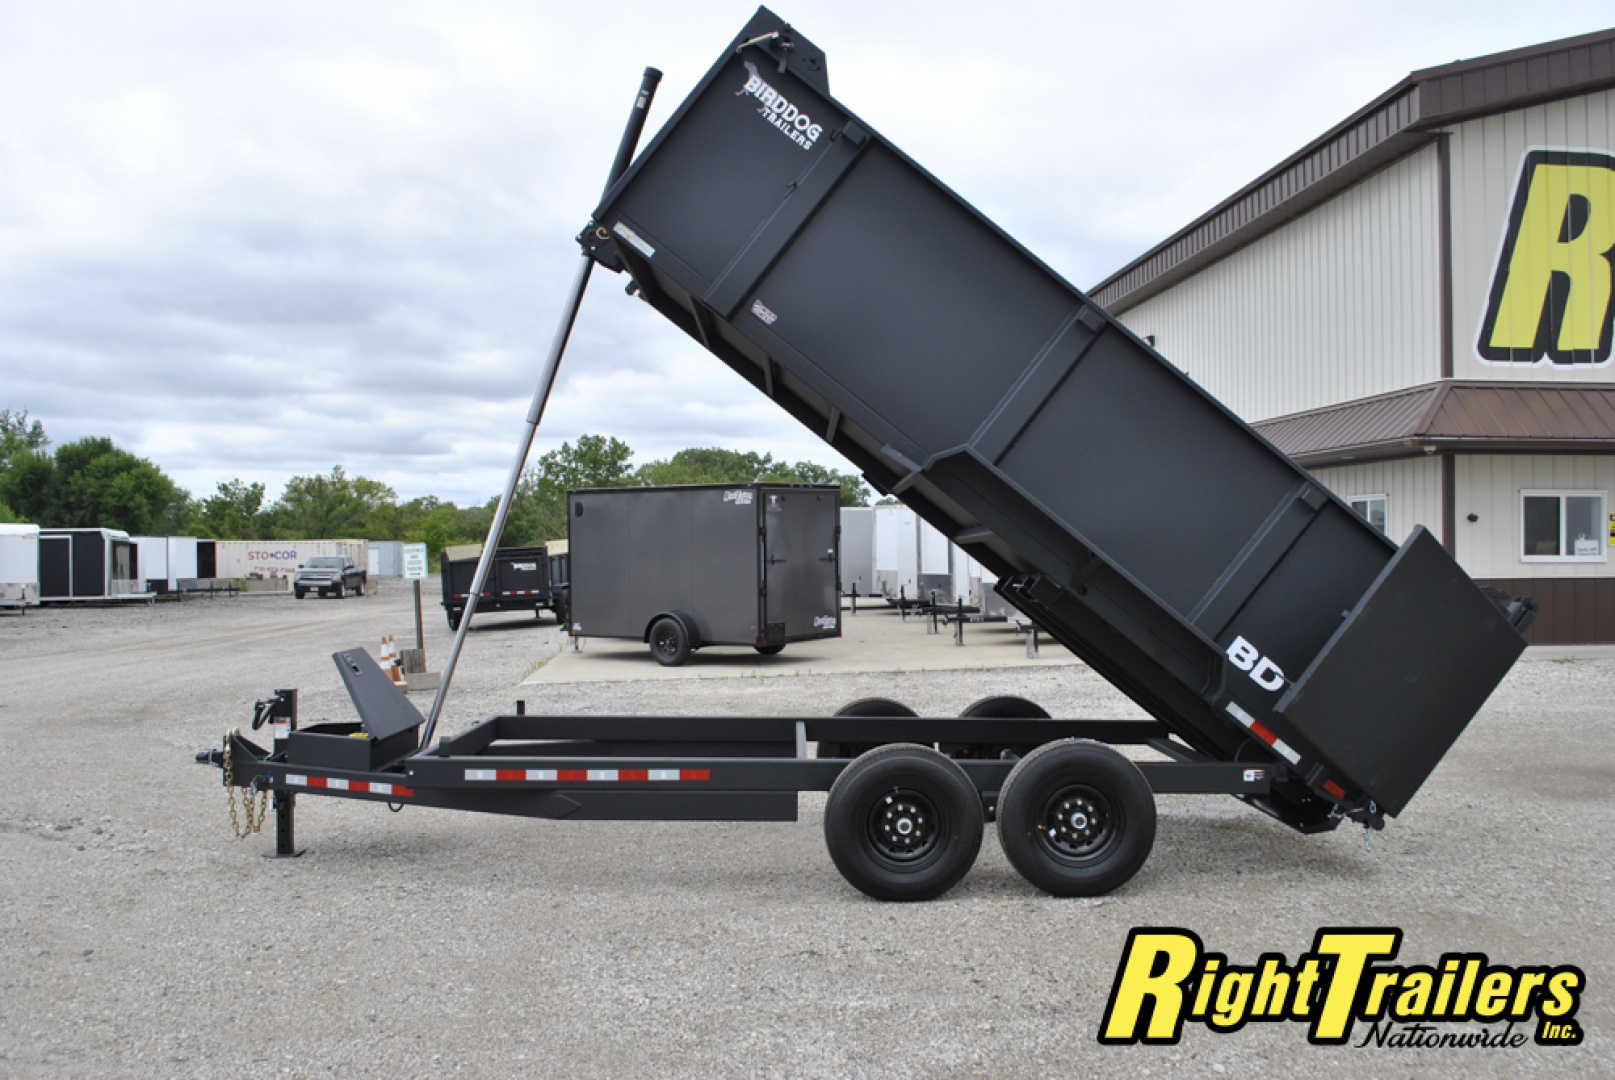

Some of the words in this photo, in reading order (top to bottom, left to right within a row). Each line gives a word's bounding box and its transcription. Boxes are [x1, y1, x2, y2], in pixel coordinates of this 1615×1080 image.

[743, 74, 823, 142] BIRDDOG
[761, 107, 813, 150] TRAILERS
[1226, 635, 1285, 691] BD
